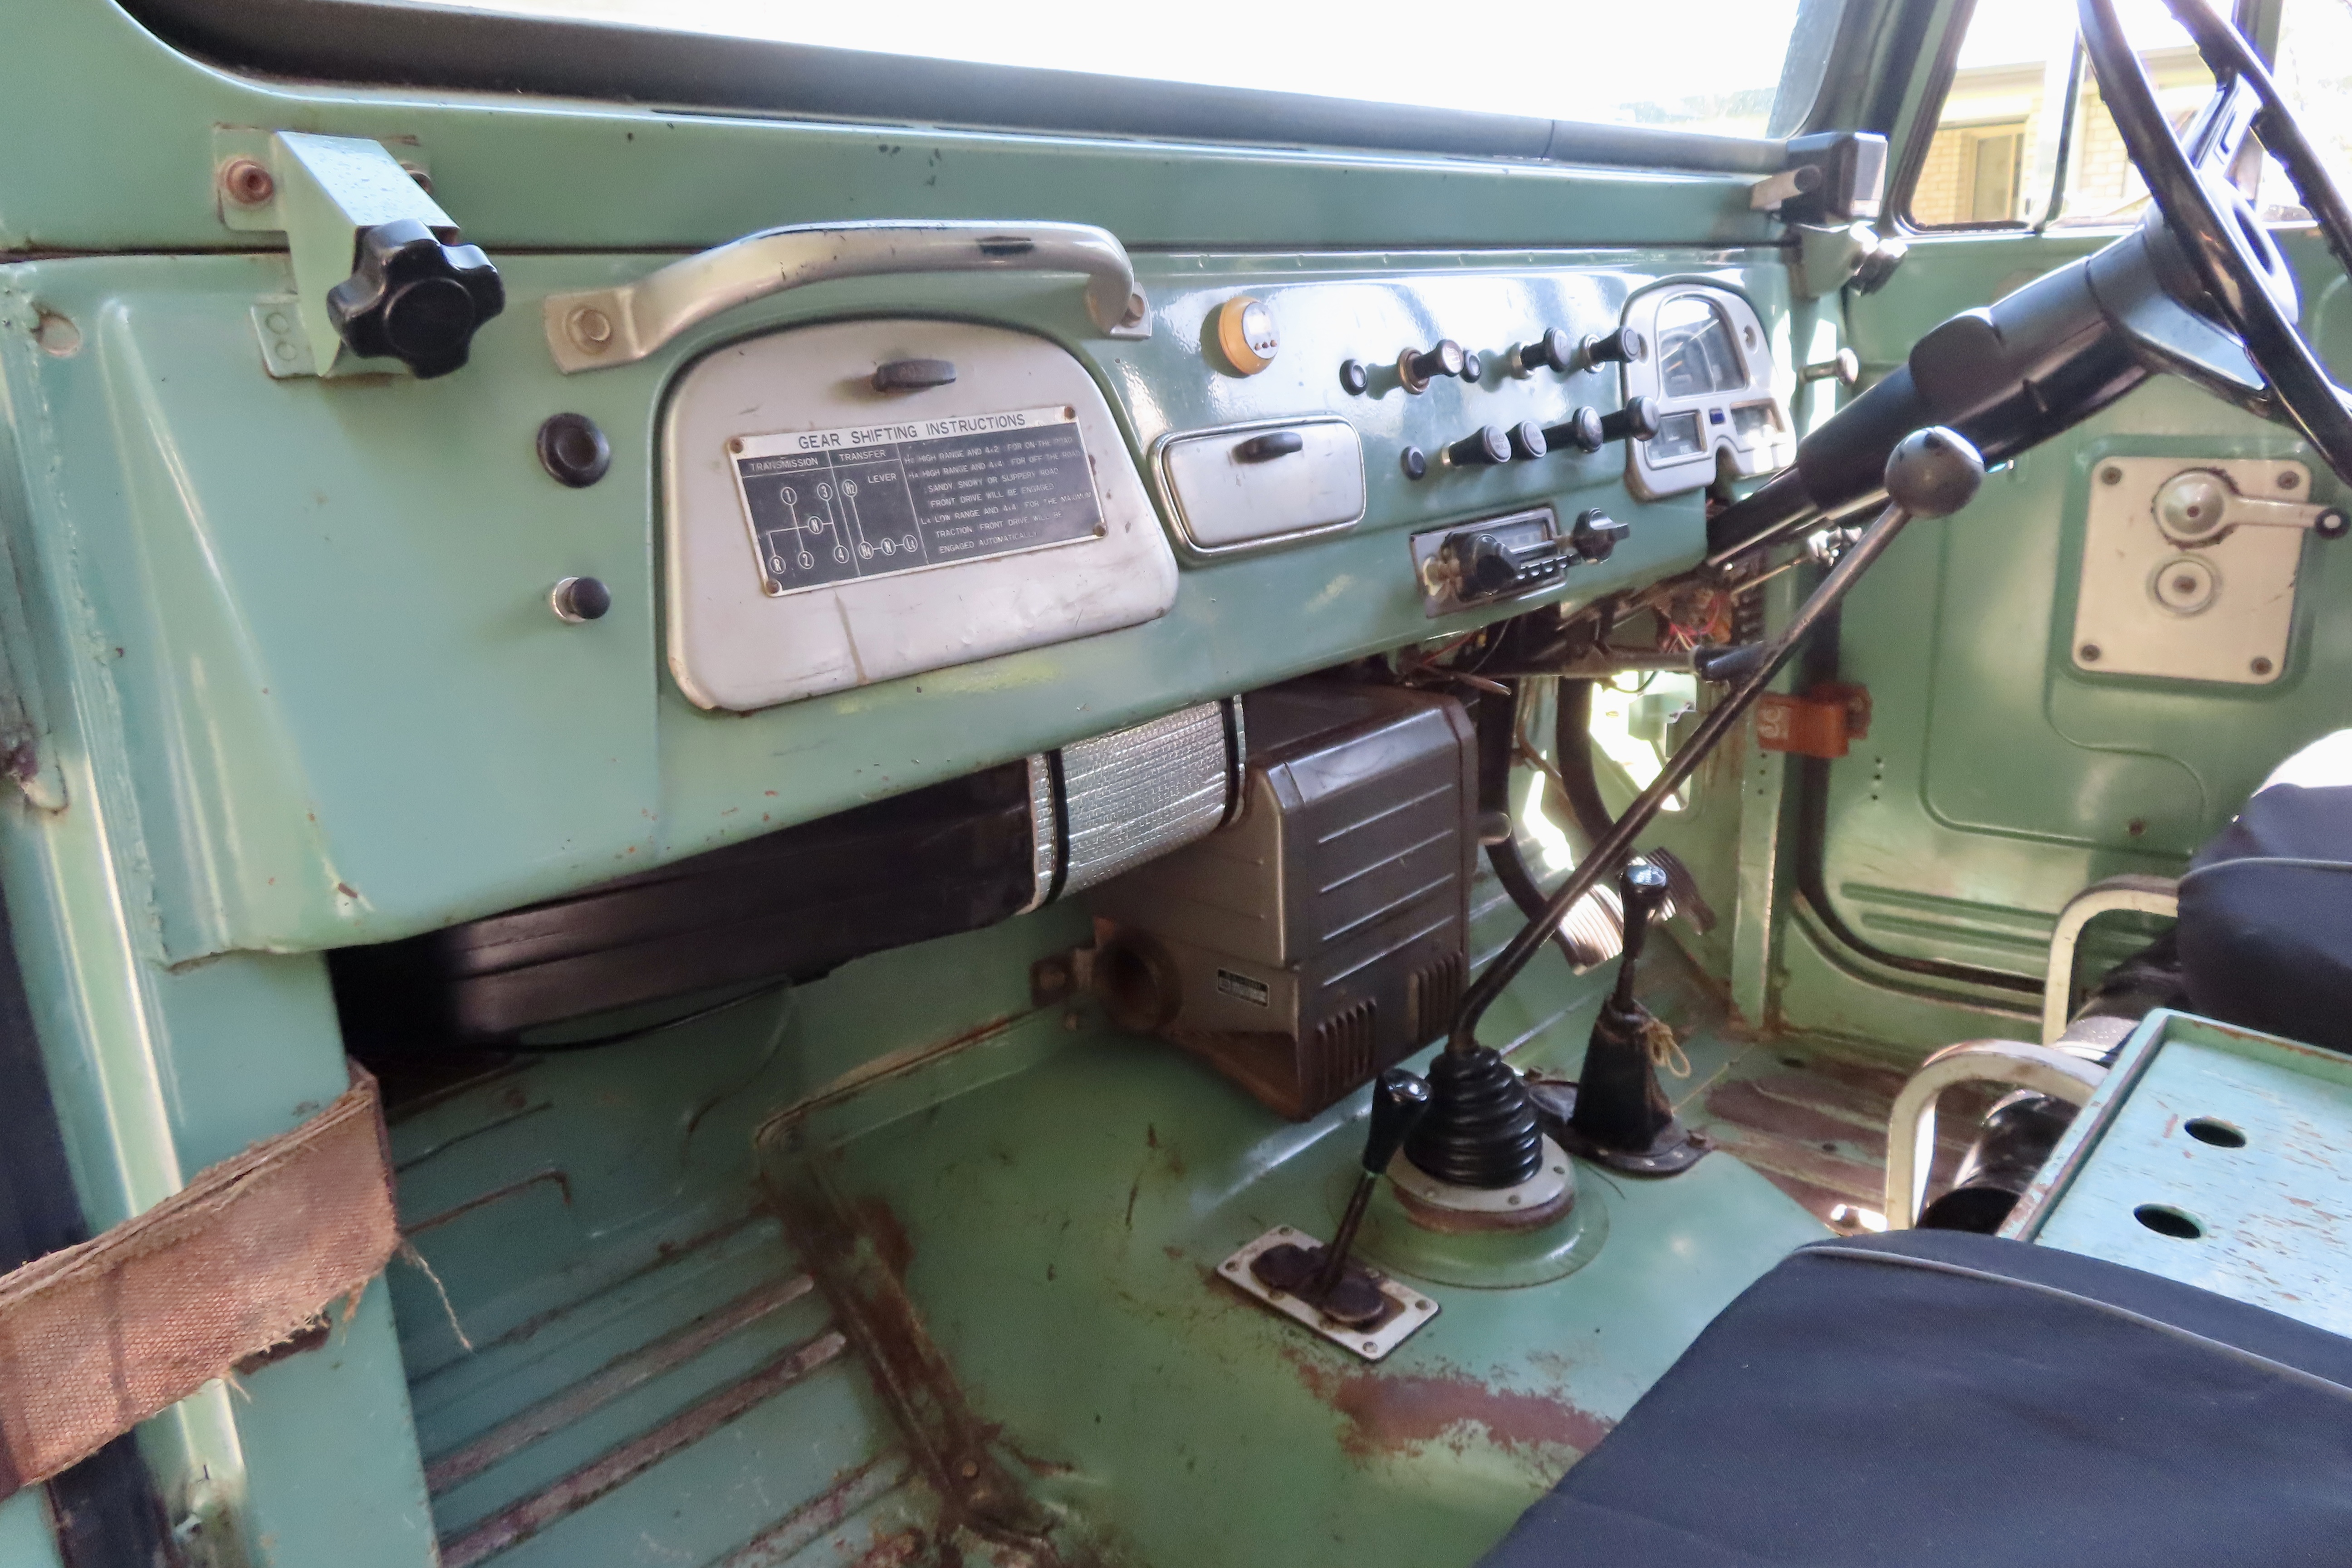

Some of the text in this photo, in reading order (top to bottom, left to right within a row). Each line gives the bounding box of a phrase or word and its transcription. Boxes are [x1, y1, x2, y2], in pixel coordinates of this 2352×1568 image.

[799, 414, 1025, 450] GEAR SHIFTING INSTRUCTIONS
[839, 450, 886, 461] TRANSFER
[939, 451, 964, 459] RANGE
[751, 457, 818, 471] TRANSMISSION
[943, 466, 969, 474] RANGE
[867, 473, 897, 484] LEVER
[958, 479, 983, 488] SNOWY
[1002, 471, 1036, 481] SLIPPERY
[821, 485, 828, 498] 3
[844, 482, 856, 495] H2
[960, 494, 982, 503] DRIVE
[986, 490, 1004, 499] WILL
[1021, 483, 1055, 494] ENGAGED
[935, 514, 951, 523] LOW
[955, 510, 980, 519] RANGE
[811, 519, 819, 532] N
[936, 526, 973, 538] TRACTION
[980, 520, 1004, 530] FRONT
[1008, 516, 1029, 525] DRIVE
[861, 544, 872, 557] H4
[884, 540, 892, 554] N
[939, 541, 975, 554] ENGAGED
[774, 559, 782, 572] R
[802, 554, 810, 567] 2
